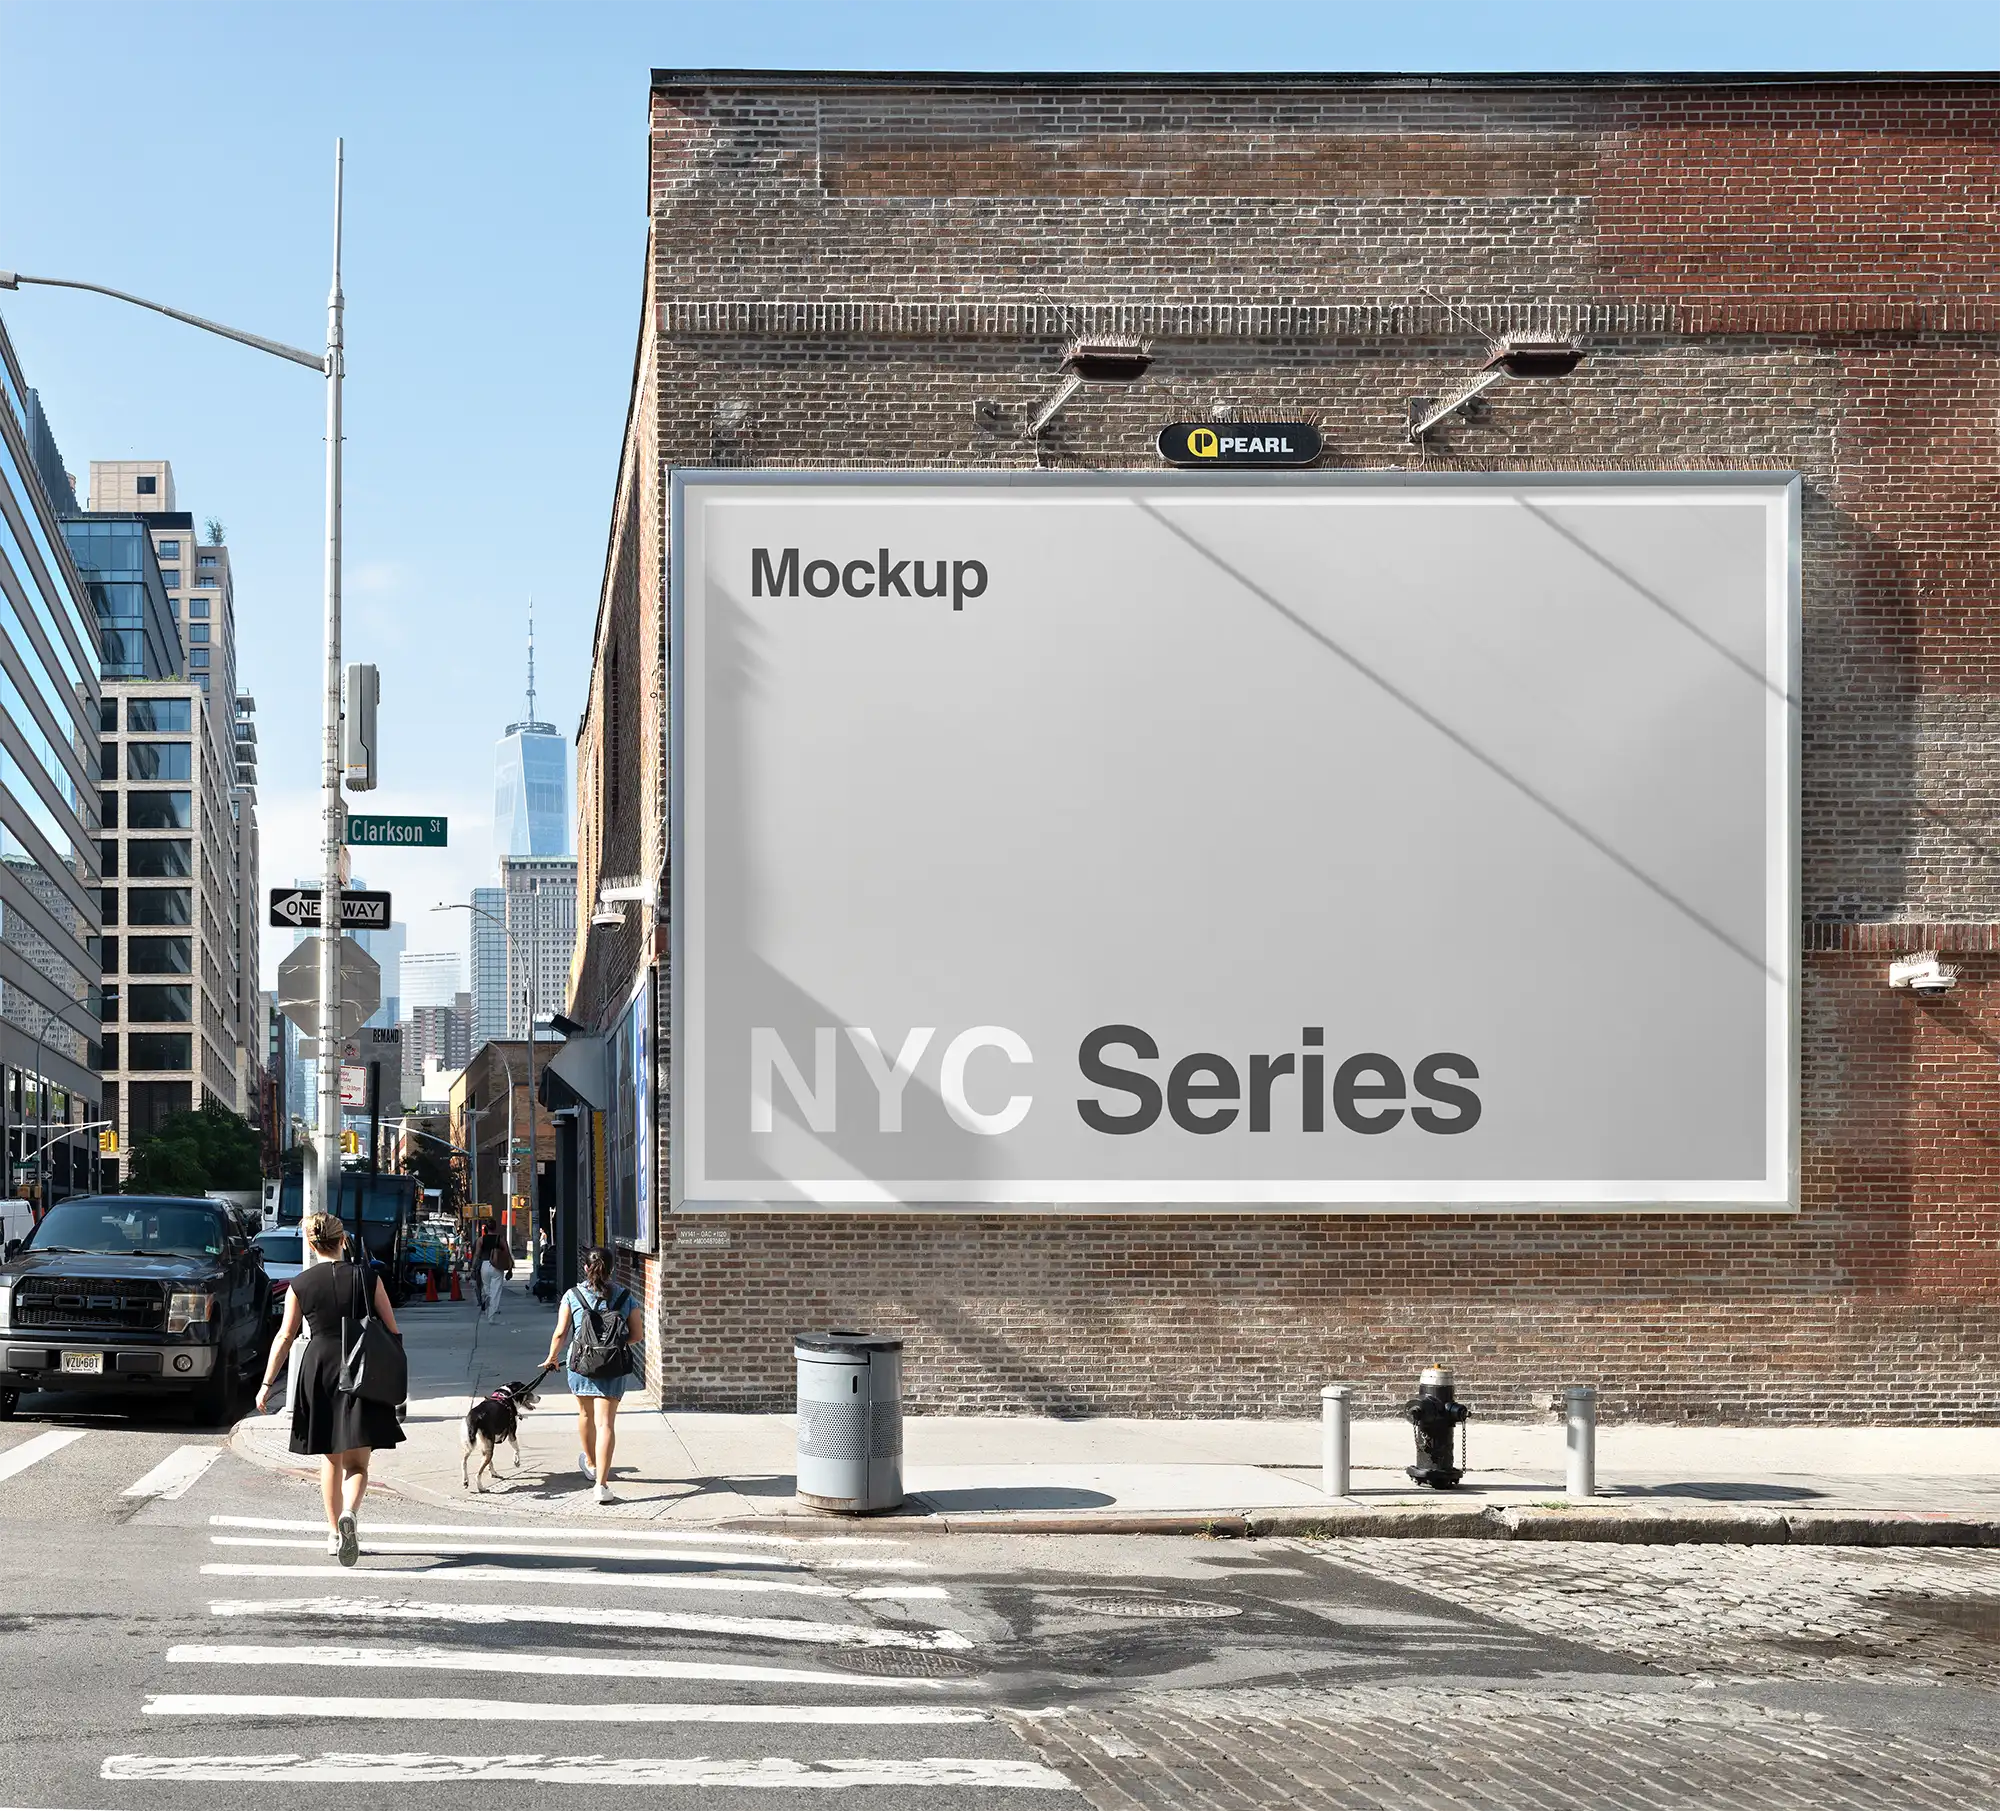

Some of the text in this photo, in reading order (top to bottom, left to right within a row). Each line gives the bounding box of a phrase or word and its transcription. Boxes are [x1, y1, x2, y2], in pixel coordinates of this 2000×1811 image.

[1220, 437, 1294, 453] PEARL
[751, 548, 989, 611] Mockup
[352, 819, 441, 842] Clarkson St
[286, 901, 380, 917] ONE WAY
[372, 1029, 399, 1043] REMAND
[750, 1024, 1483, 1136] NYC Series
